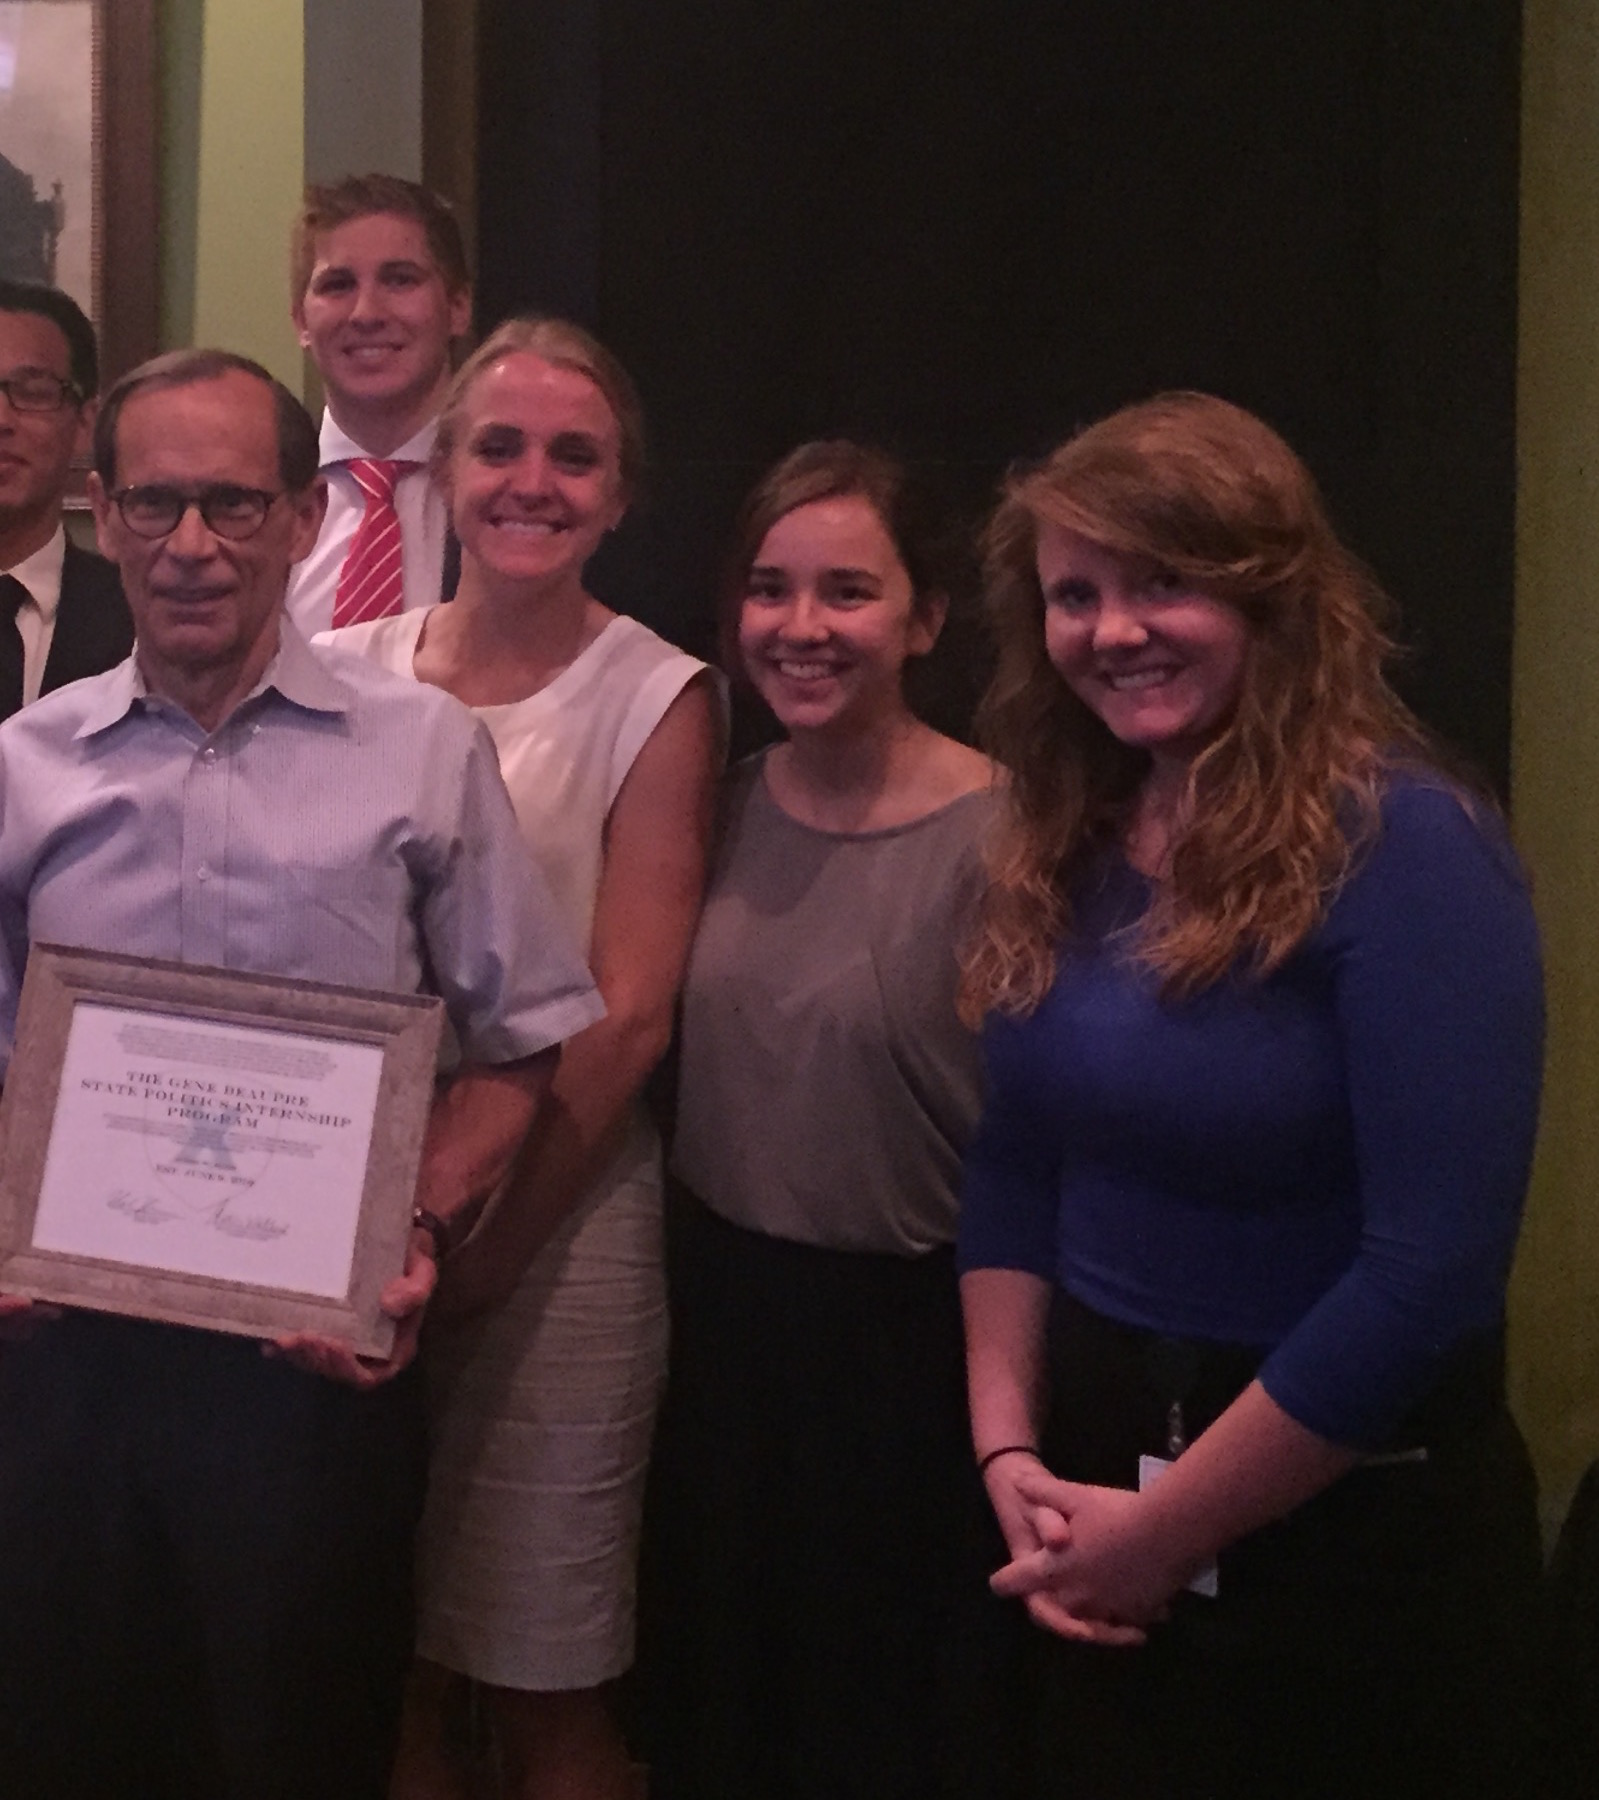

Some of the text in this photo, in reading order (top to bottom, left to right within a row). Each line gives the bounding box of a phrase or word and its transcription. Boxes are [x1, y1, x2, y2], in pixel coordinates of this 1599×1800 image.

[127, 1070, 162, 1086] THE
[168, 1077, 217, 1094] GENE
[81, 1079, 351, 1127] STATE POLITICS INTERNSHIP
[166, 1106, 259, 1129] PROGRAM
